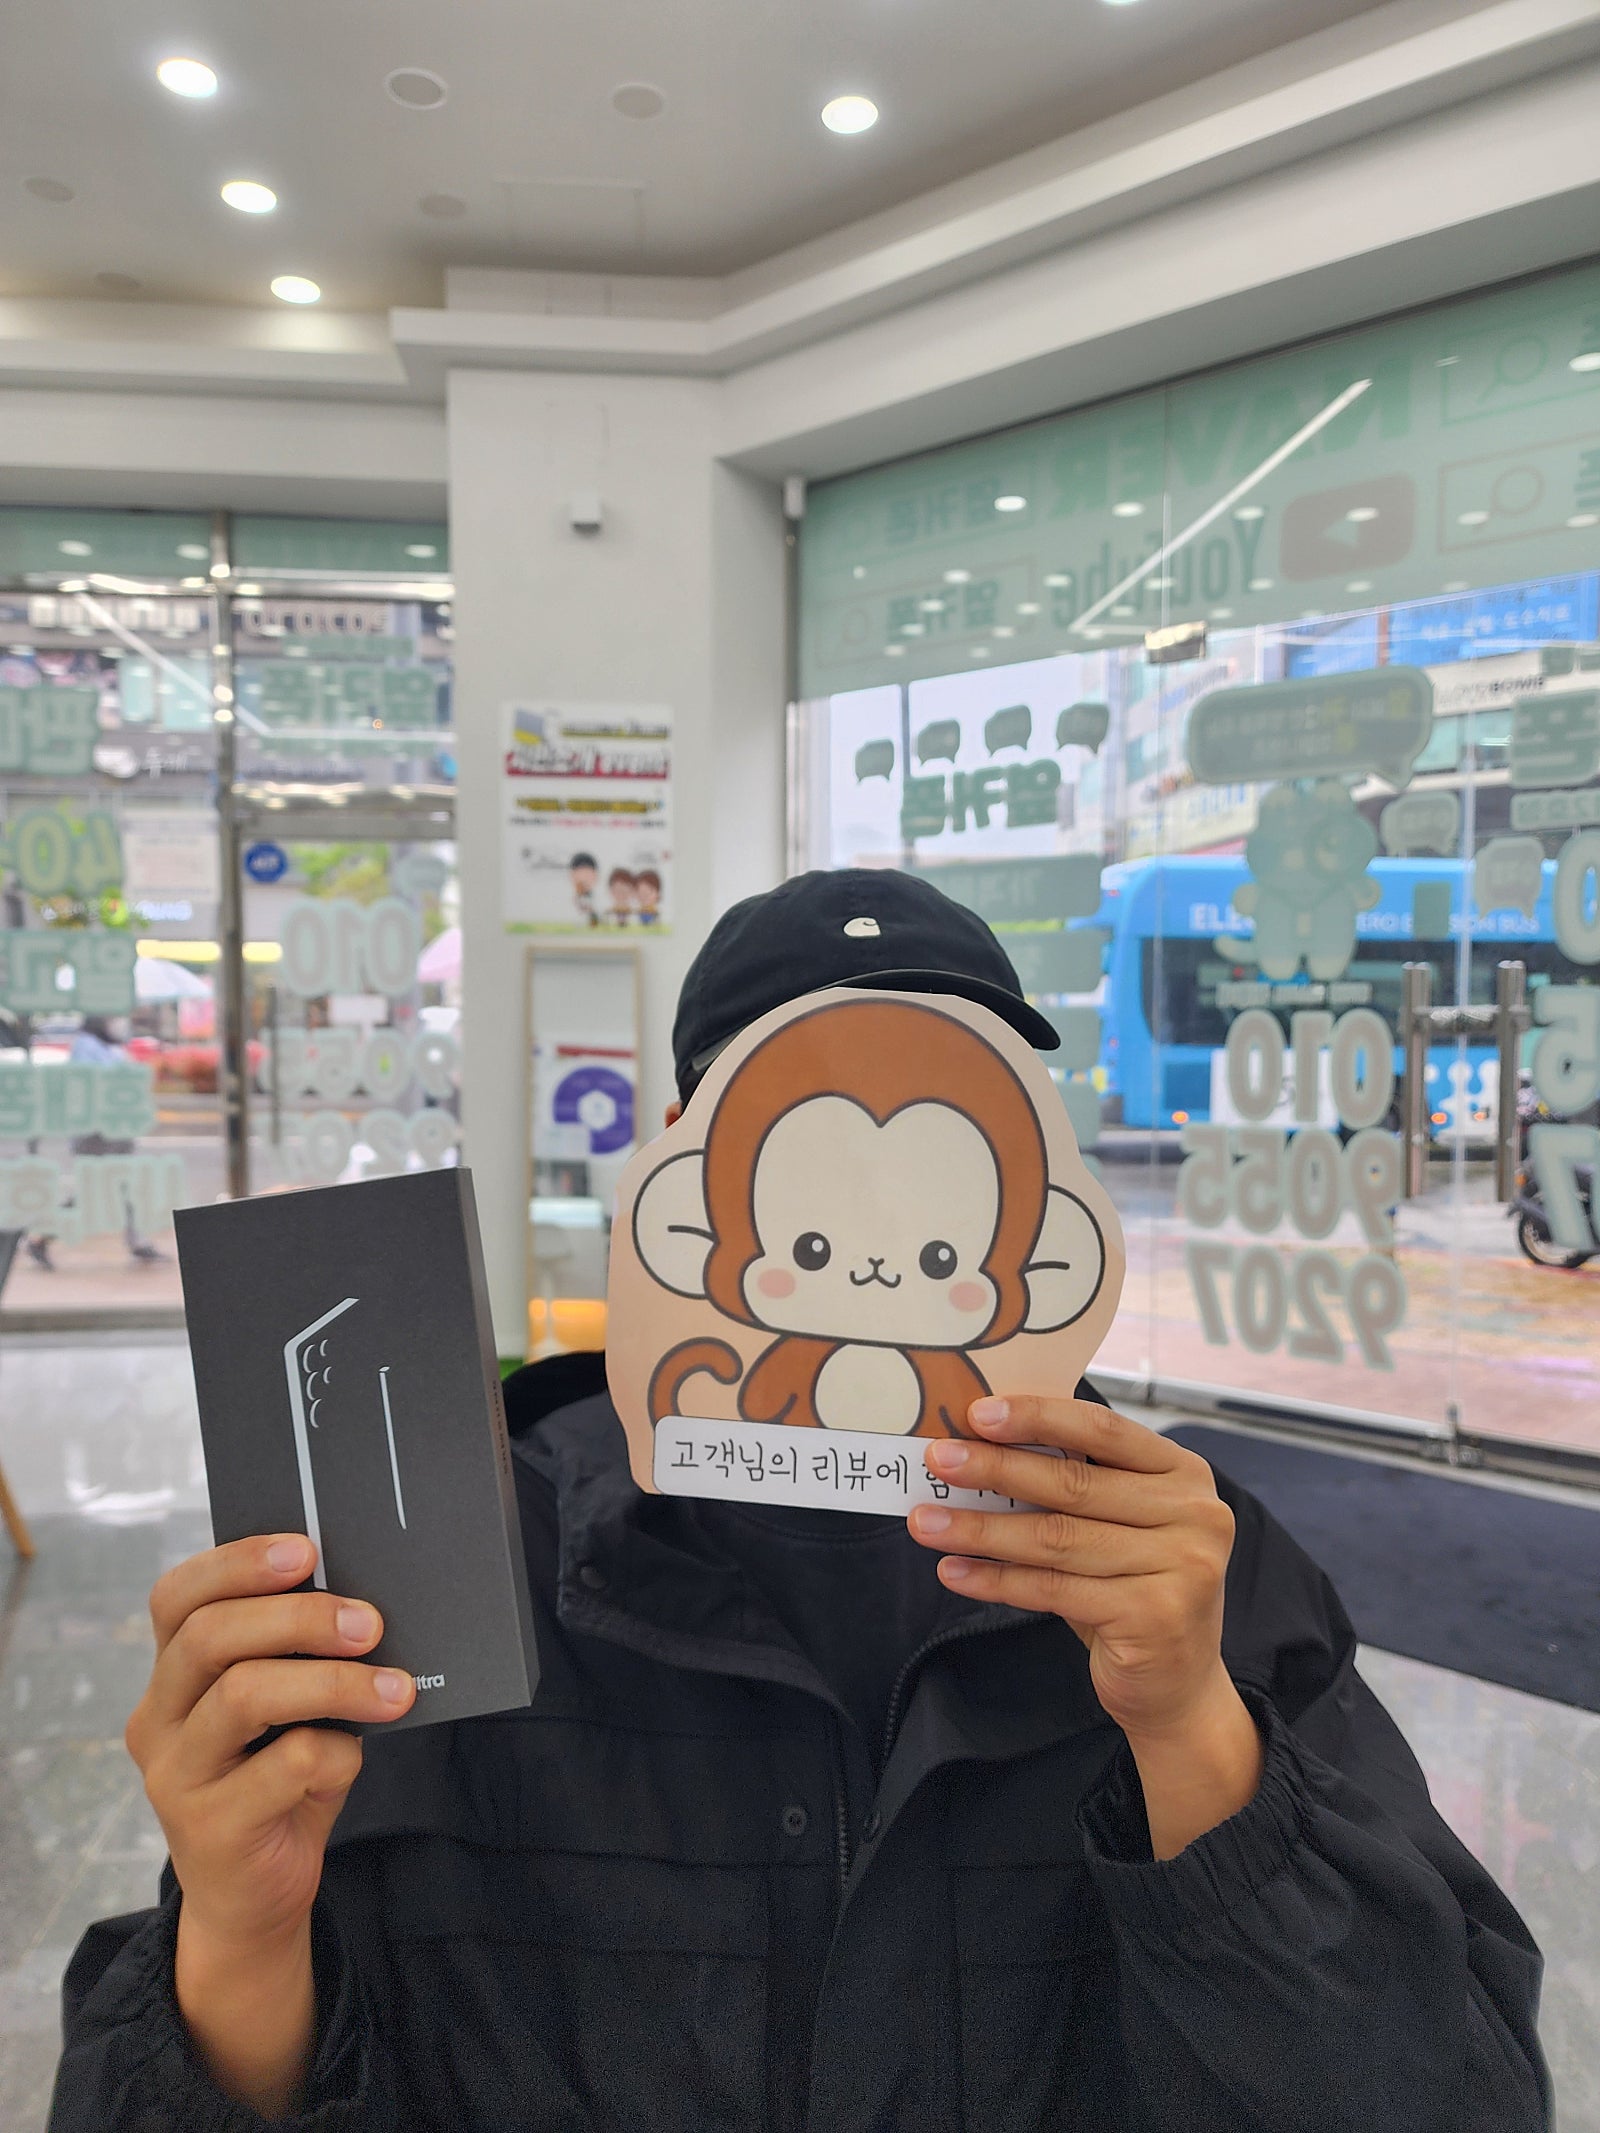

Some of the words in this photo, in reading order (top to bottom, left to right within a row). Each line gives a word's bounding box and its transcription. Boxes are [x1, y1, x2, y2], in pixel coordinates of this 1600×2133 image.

[670, 1438, 798, 1485] 고객님의
[811, 1446, 909, 1495] 리뷰에
[412, 1673, 446, 1692] ltra
